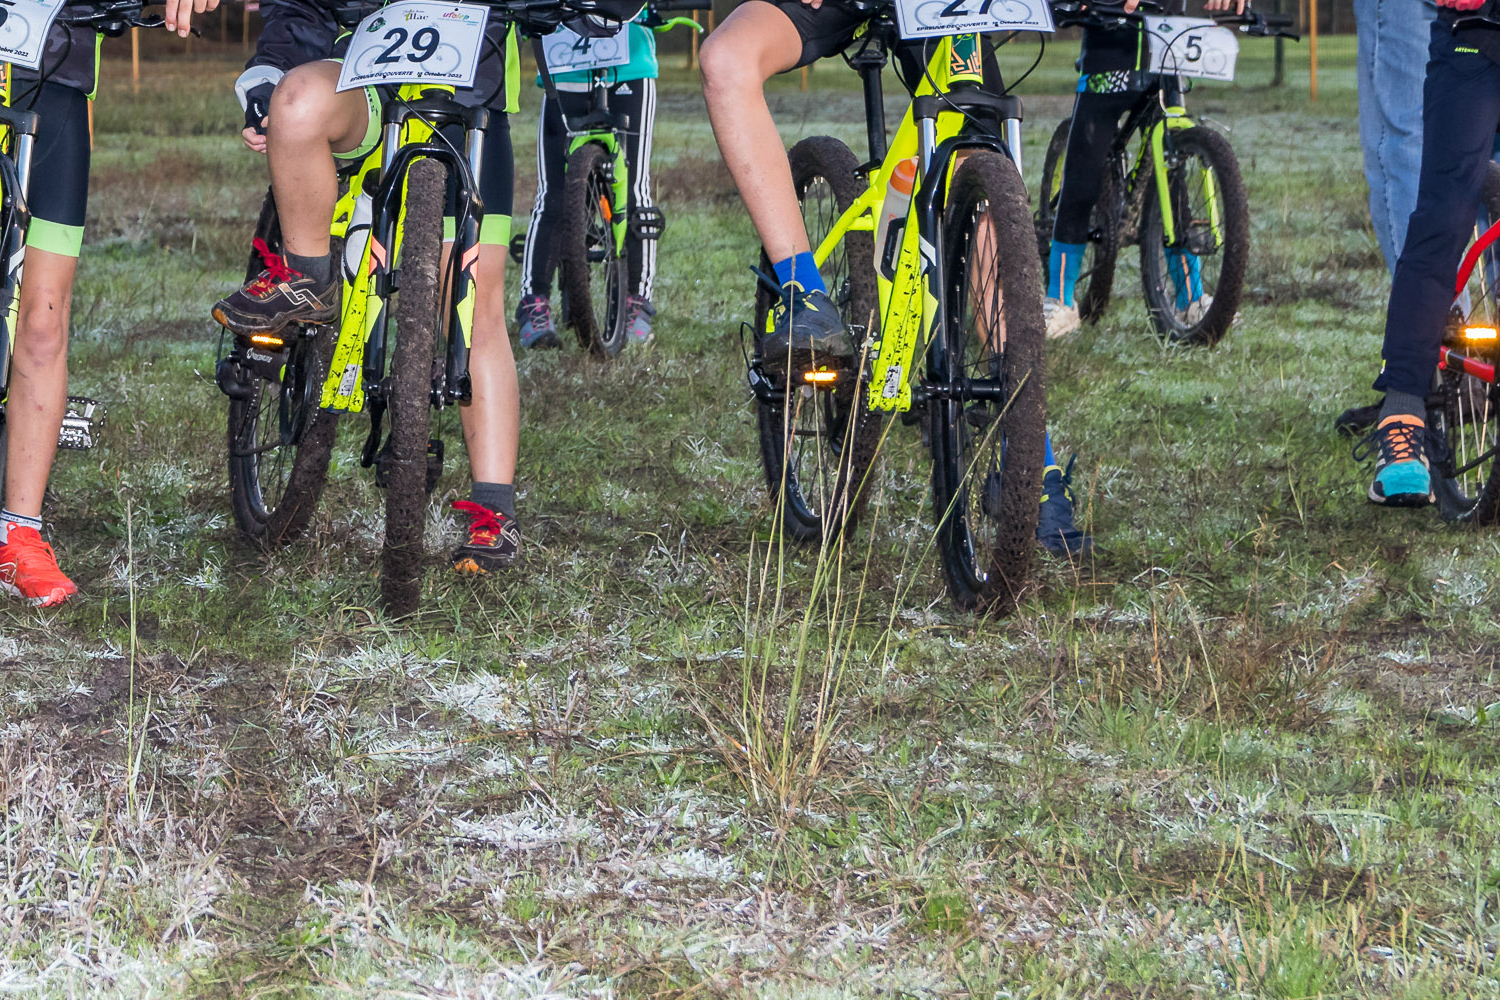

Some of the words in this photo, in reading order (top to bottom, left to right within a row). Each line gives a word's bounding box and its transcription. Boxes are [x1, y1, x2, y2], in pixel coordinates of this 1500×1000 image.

[374, 27, 440, 65] 29
[572, 36, 591, 54] 4
[1185, 36, 1202, 62] 5
